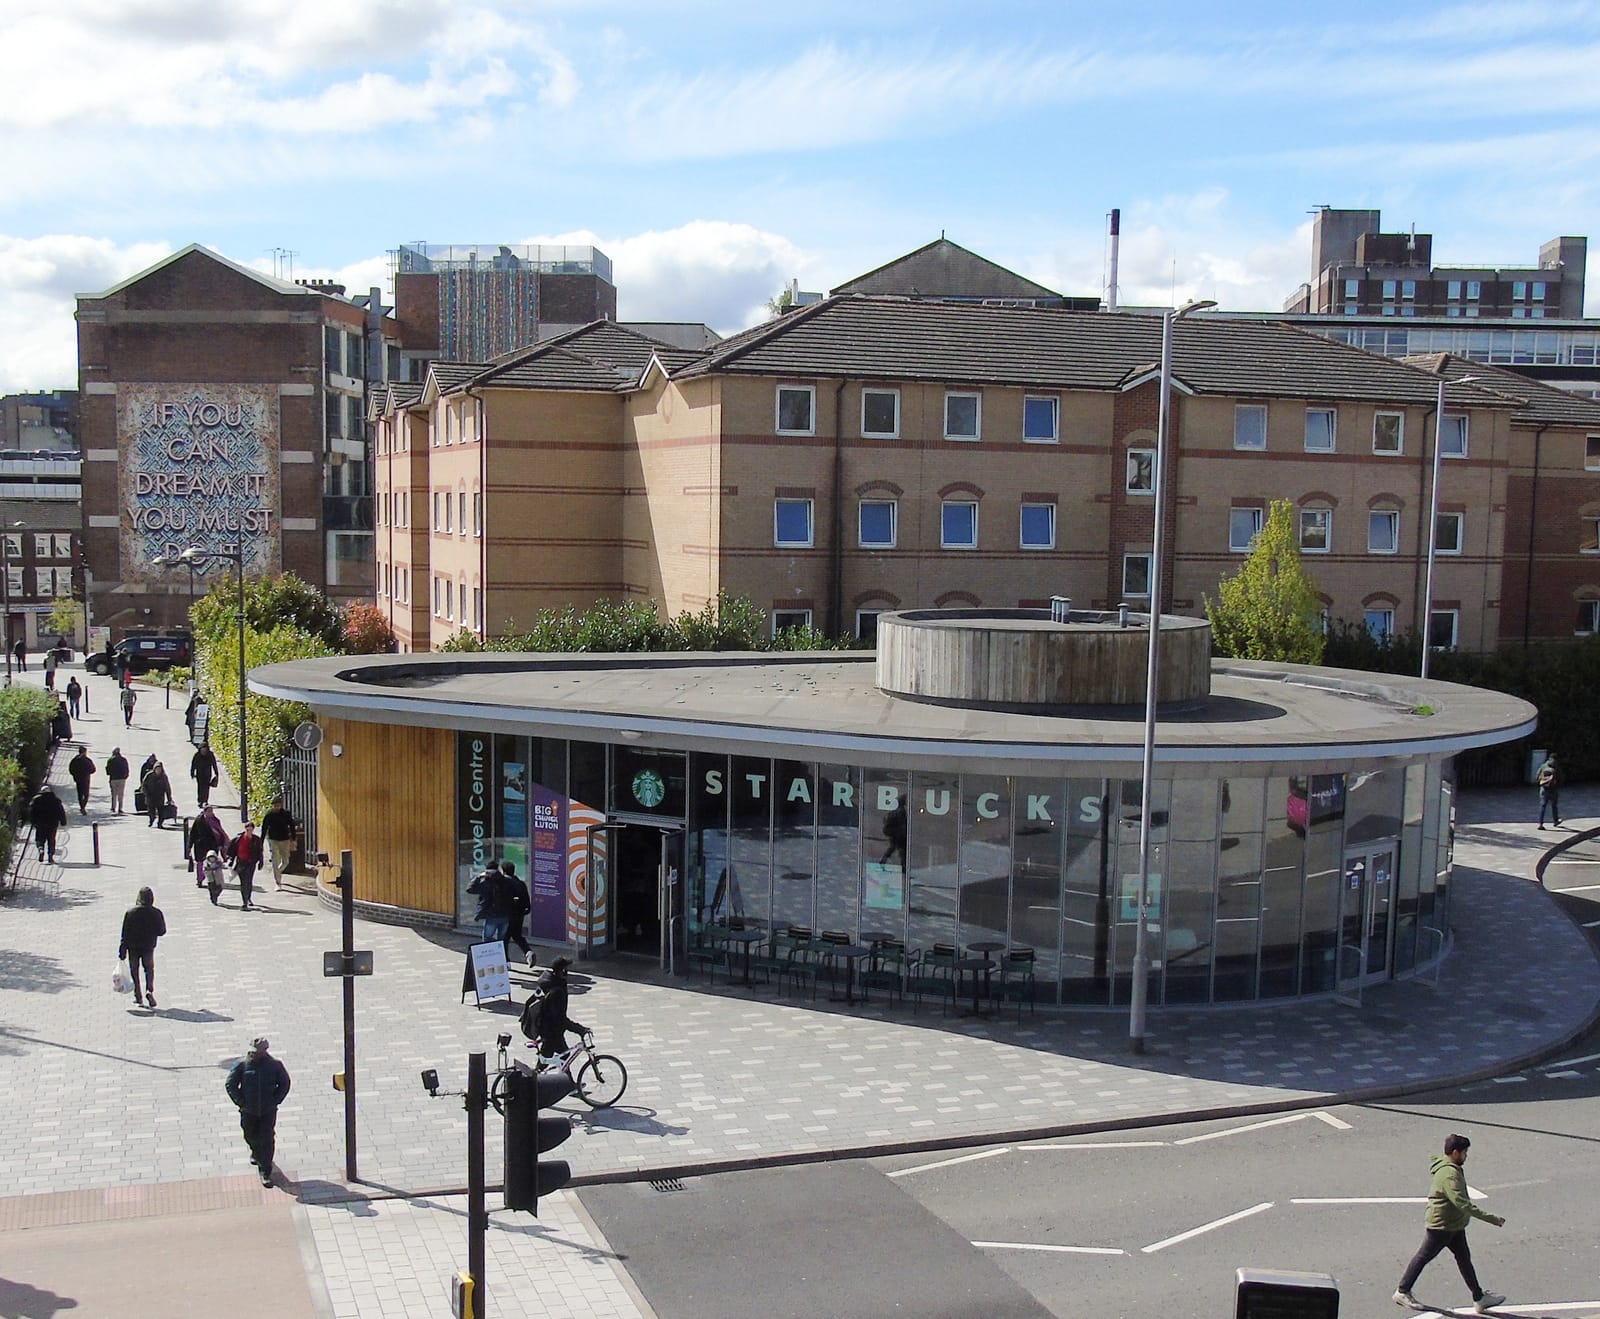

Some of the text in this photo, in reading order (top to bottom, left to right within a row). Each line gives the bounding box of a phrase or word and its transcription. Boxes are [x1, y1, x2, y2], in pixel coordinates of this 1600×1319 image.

[153, 402, 242, 427] IF YOU
[167, 438, 229, 463] CAN
[135, 472, 265, 497] DREAM IT
[127, 507, 273, 532] YOU MUST
[219, 543, 239, 565] IT
[469, 738, 484, 812] Centre
[705, 769, 1101, 823] STARBUCKS
[534, 804, 552, 816] BIG
[534, 821, 559, 831] LUTON
